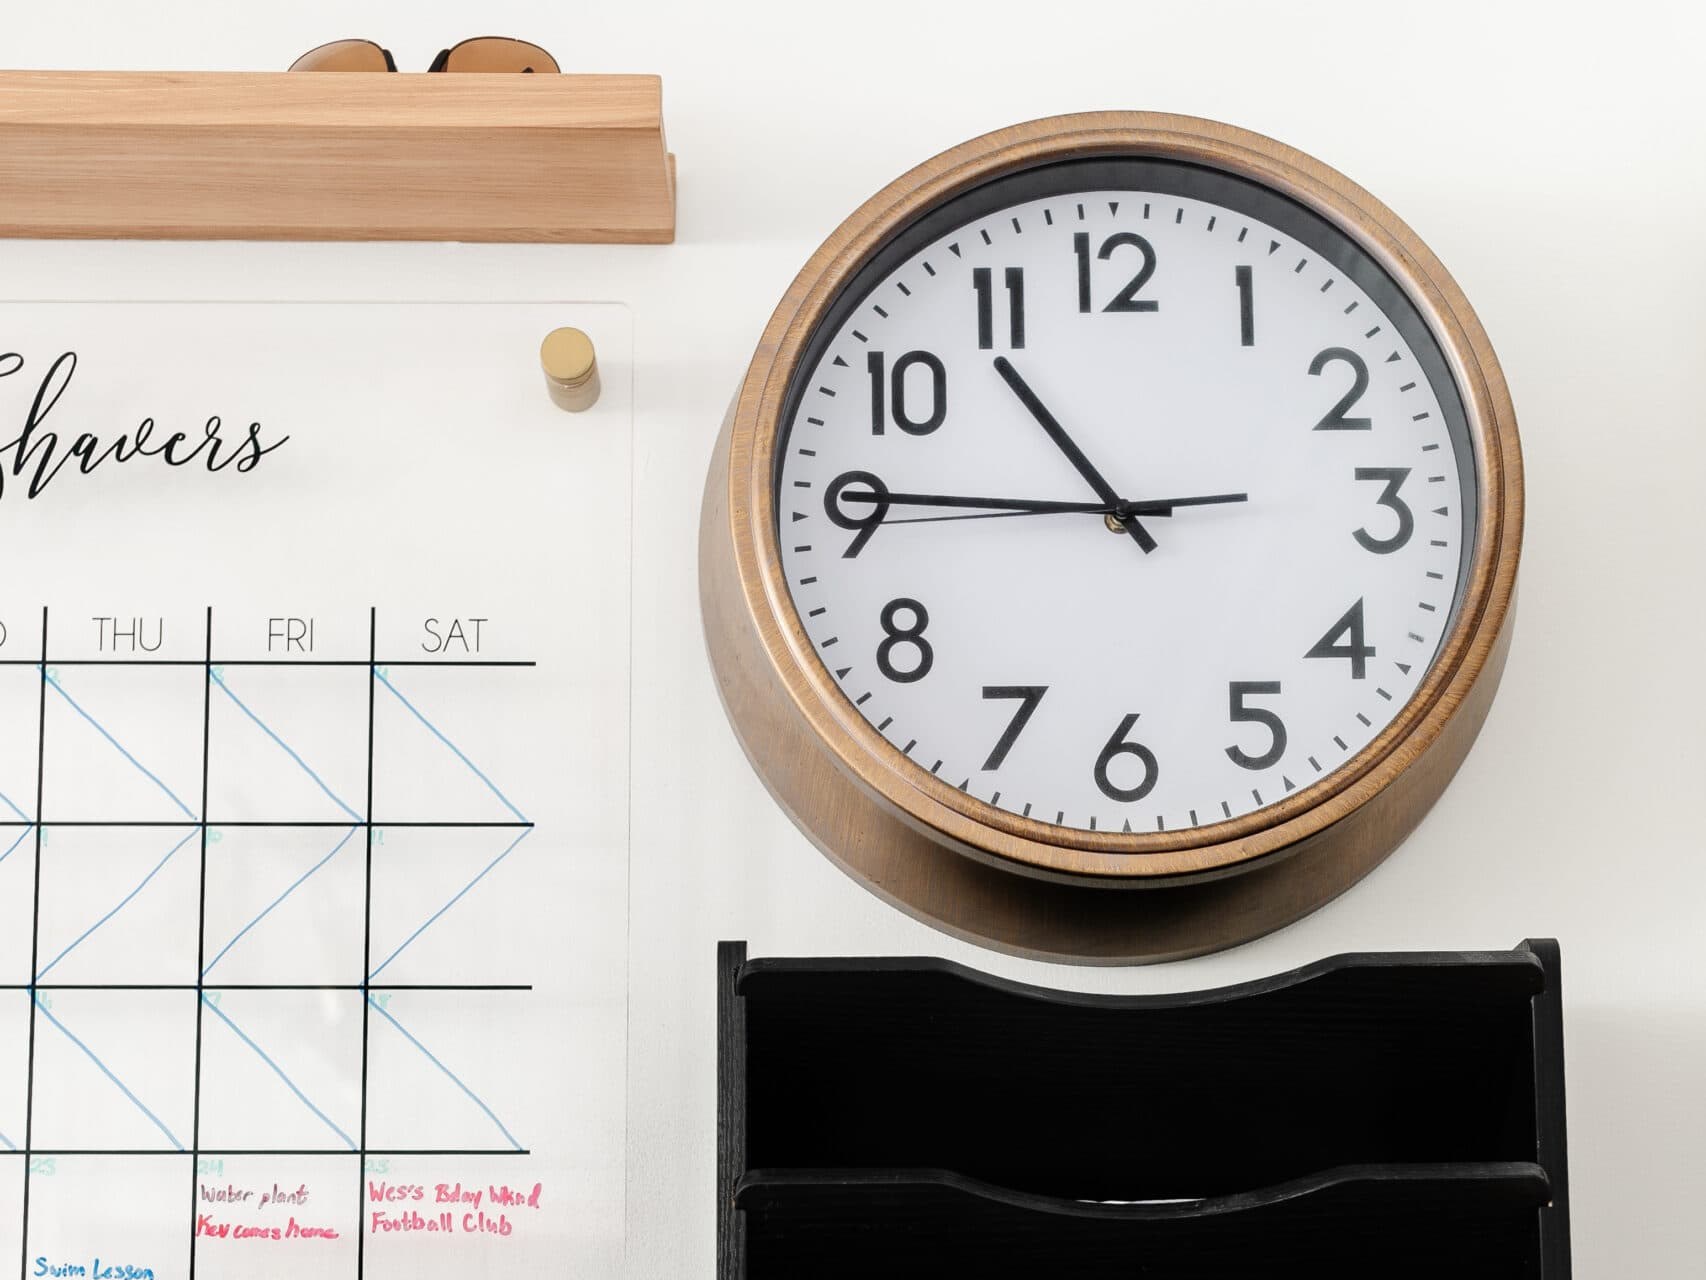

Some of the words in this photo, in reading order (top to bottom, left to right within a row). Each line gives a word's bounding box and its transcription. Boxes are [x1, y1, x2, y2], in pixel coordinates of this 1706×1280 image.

[973, 267, 1024, 349] 11
[1074, 232, 1158, 314] 12
[1236, 266, 1255, 346] 1
[867, 351, 947, 436] 10
[1308, 347, 1372, 431] 2
[824, 471, 890, 559] 9
[1352, 468, 1414, 555] 3
[92, 617, 163, 652] THU
[268, 617, 314, 652] FRI
[421, 617, 488, 653] SAT
[876, 598, 934, 683] 8
[1303, 597, 1376, 679] 4
[982, 686, 1049, 771] 7
[1094, 713, 1158, 802] 6
[1225, 681, 1288, 770] 5
[258, 1183, 310, 1210] plant
[371, 1210, 453, 1233] Football
[462, 1211, 513, 1236] Club
[434, 1182, 482, 1210] Bday
[33, 1256, 86, 1277] Swim
